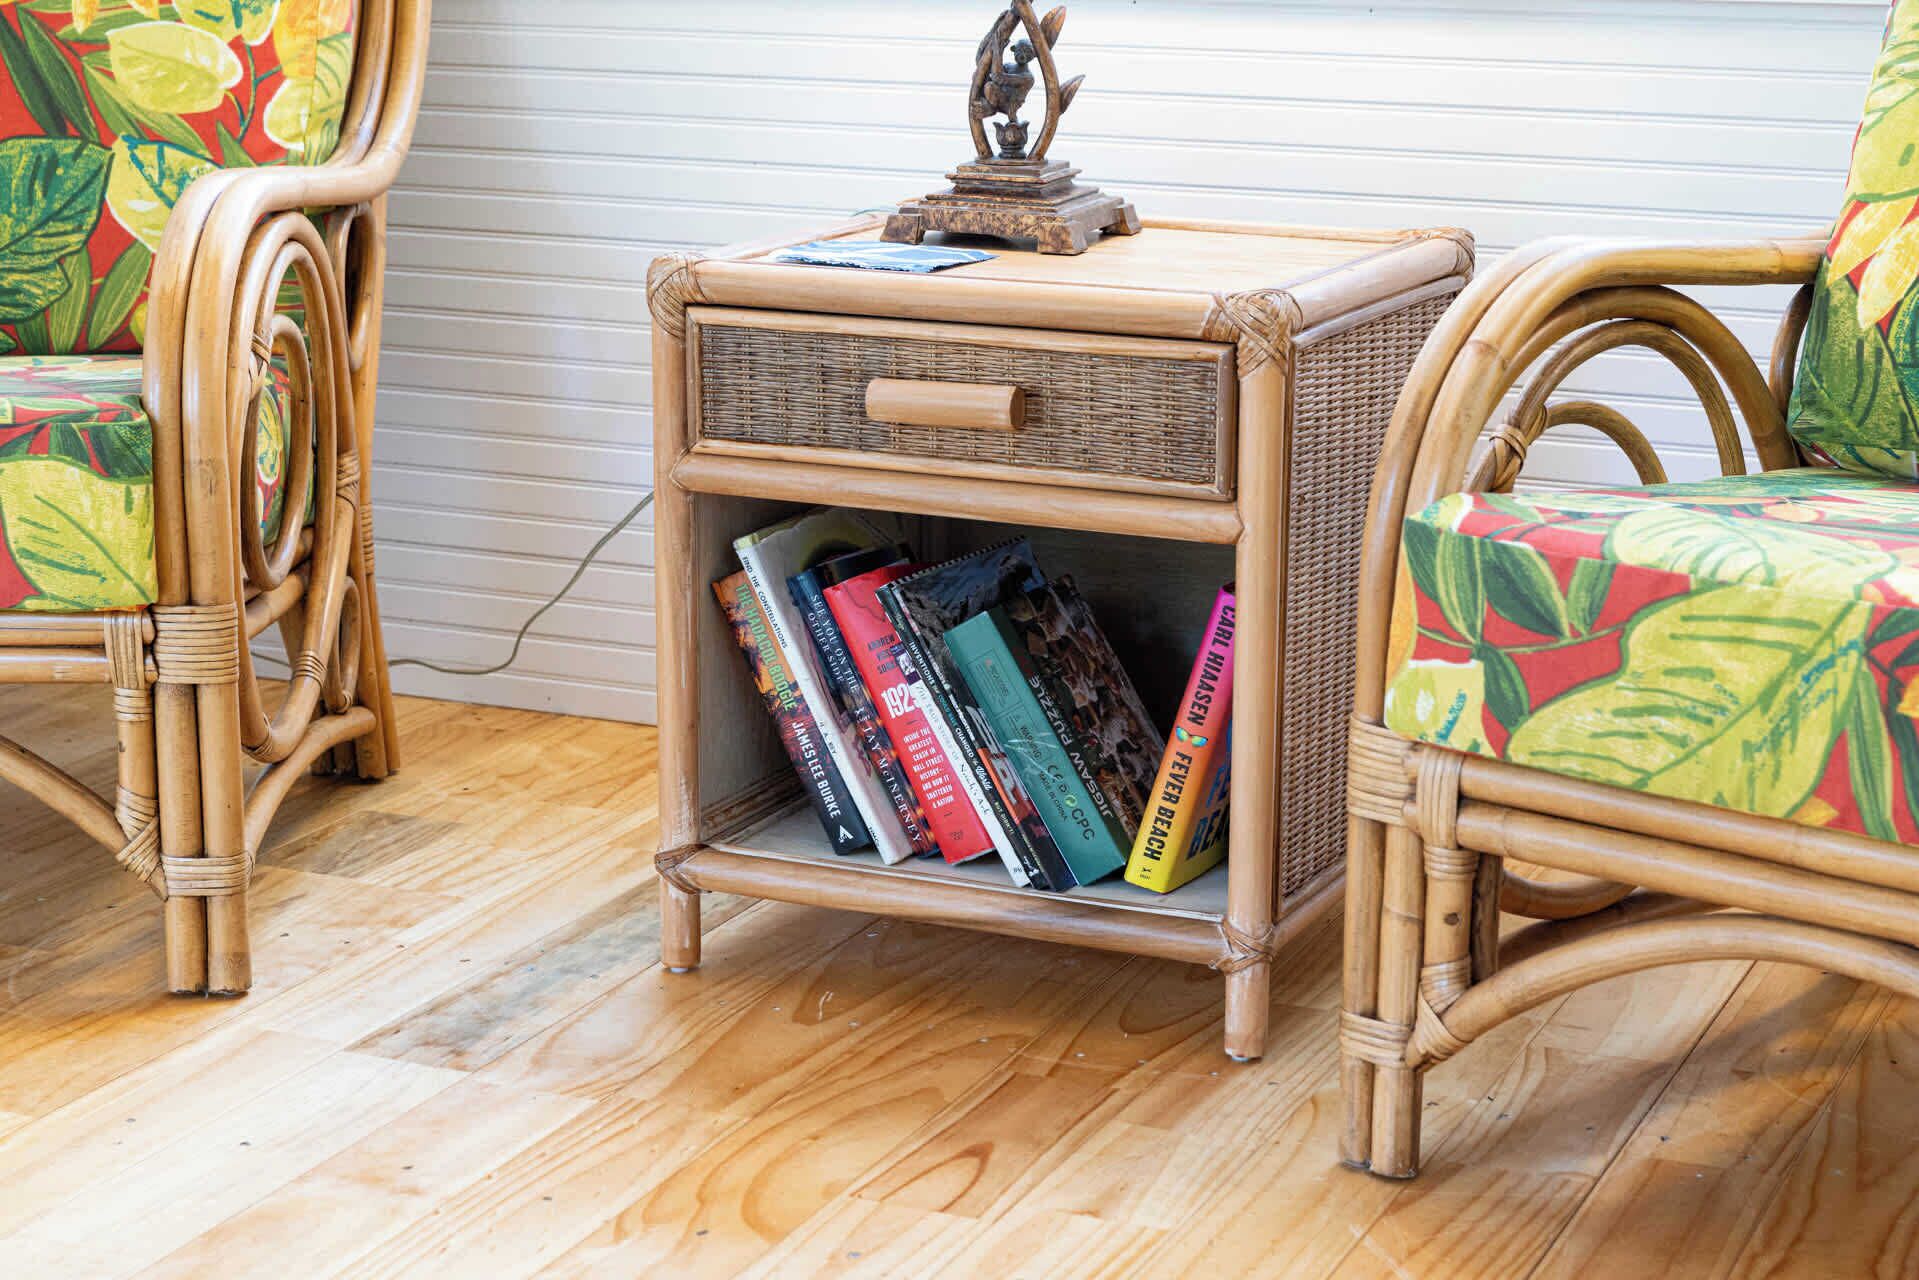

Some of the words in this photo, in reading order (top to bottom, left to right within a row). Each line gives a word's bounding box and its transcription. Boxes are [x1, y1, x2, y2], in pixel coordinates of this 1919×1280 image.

[736, 583, 754, 608] THE
[742, 556, 753, 574] FIND
[751, 576, 760, 588] THE
[758, 591, 788, 649] CONSTELLATIONS
[1211, 605, 1236, 648] CARL
[744, 607, 778, 666] HADACOL
[808, 612, 830, 653] OTHER
[828, 655, 845, 682] SIDE
[812, 594, 827, 617] SEE
[822, 619, 839, 645] YOU
[835, 648, 847, 665] ON
[843, 667, 860, 693] THE
[768, 664, 798, 712] BOOGIE
[908, 641, 936, 687] INVENTIONS
[955, 727, 974, 758] CHANGED
[975, 765, 993, 791] World
[1029, 673, 1073, 746] PUZZLE
[1187, 650, 1225, 726] HIAASEN
[792, 721, 817, 759] JAMES
[808, 758, 825, 779] LEE
[817, 779, 841, 819] BURKE
[863, 727, 881, 752] JAY
[879, 757, 923, 842] McINERNEY
[1070, 751, 1114, 818] JIGSAW
[1160, 751, 1193, 806] FEVER
[1143, 806, 1176, 861] BEACH
